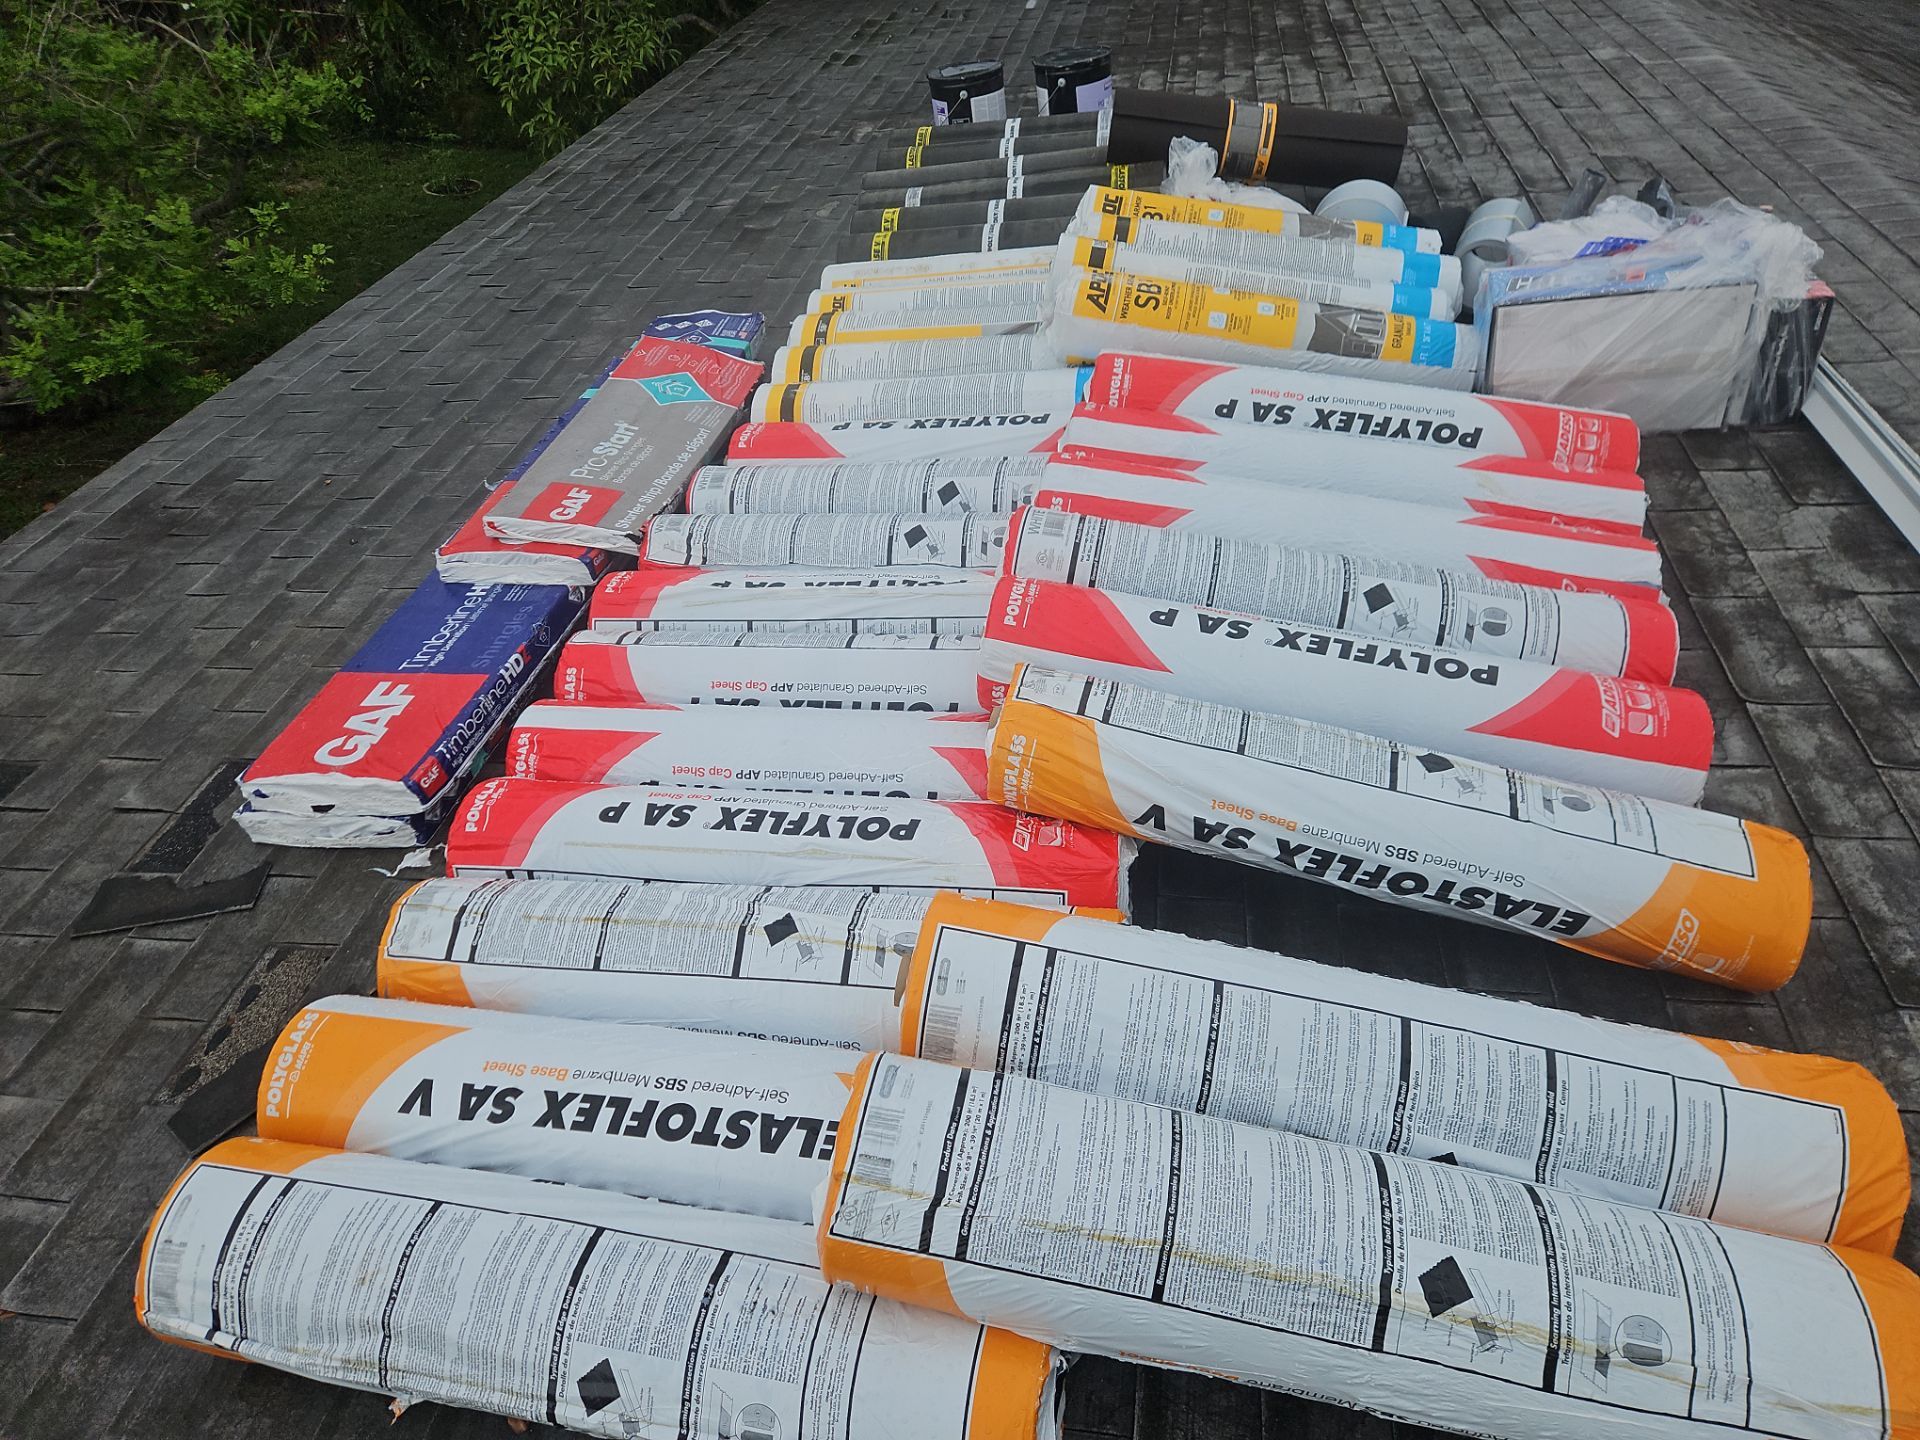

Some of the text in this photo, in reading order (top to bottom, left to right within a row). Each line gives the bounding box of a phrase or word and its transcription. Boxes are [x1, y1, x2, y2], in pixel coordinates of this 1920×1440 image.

[1250, 387, 1281, 398] Sheet
[1282, 390, 1305, 402] Cap
[1307, 394, 1330, 404] APP
[1214, 399, 1238, 419] P
[1252, 401, 1297, 425] SA
[684, 426, 713, 454] départ
[676, 449, 693, 466] de
[550, 487, 593, 521] GAF
[615, 500, 647, 530] Starter
[1028, 510, 1045, 535] WHITE
[1149, 608, 1180, 628] P
[1196, 612, 1253, 640] SA
[710, 679, 928, 696] Self-Adhered Granulated APP Cap Sheet
[314, 680, 416, 766] GAF
[420, 764, 440, 788] GAF
[671, 764, 904, 783] Self-Adhered Granulated APP Cap Sheet
[598, 801, 631, 824] P
[644, 802, 698, 829] SA
[1210, 799, 1526, 889] Self-Adhered SBS Membrane Base Sheet
[1133, 803, 1591, 937] ELASTOFLEX SA V
[1033, 965, 1054, 1044] & Application Methods
[1211, 994, 1222, 1029] Aplicación
[1209, 1030, 1217, 1040] de
[266, 1012, 320, 1118] POLYGLASS
[1203, 1040, 1217, 1072] Métodos
[482, 1060, 790, 1104] Self-Adhered SBS Membrane Base Sheet
[398, 1078, 434, 1117] V
[458, 1082, 525, 1124] SA
[1392, 1081, 1408, 1140] Roof Edge Detail
[1402, 1070, 1421, 1147] borde de techo típico
[1557, 1080, 1569, 1144] en Campo
[964, 1114, 973, 1127] 200
[1541, 1114, 1556, 1152] Treatment
[940, 1121, 958, 1172] Product Data
[1172, 1142, 1182, 1168] Métodos
[960, 1206, 974, 1236] General
[967, 1136, 991, 1207] Recommendations
[986, 1095, 1001, 1129] Application
[1167, 1175, 1180, 1214] Generales
[1395, 1197, 1404, 1214] techo
[242, 1193, 285, 1275] & Application Methods
[1381, 1188, 1395, 1274] Typical Roof Edge Detail
[1397, 1216, 1405, 1225] de
[391, 1255, 408, 1291] Métodos
[404, 1245, 412, 1256] de
[408, 1209, 433, 1247] Aplicación
[1396, 1227, 1407, 1250] borde
[1559, 1242, 1567, 1251] en
[213, 1263, 223, 1281] Data
[1396, 1252, 1404, 1263] de
[1394, 1264, 1404, 1294] Detalle
[1547, 1257, 1561, 1305] Intersection
[1562, 1252, 1575, 1299] intersección
[706, 1303, 719, 1330] juntas
[1564, 1301, 1572, 1313] de
[550, 1285, 575, 1381] Typical Roof Edge Detail
[559, 1273, 590, 1398] Detalle de borde de techo típico
[705, 1331, 712, 1342] en
[684, 1351, 695, 1400] Intersection
[691, 1307, 707, 1351] Treatment
[697, 1343, 709, 1393] intersección
[693, 1394, 701, 1405] de
